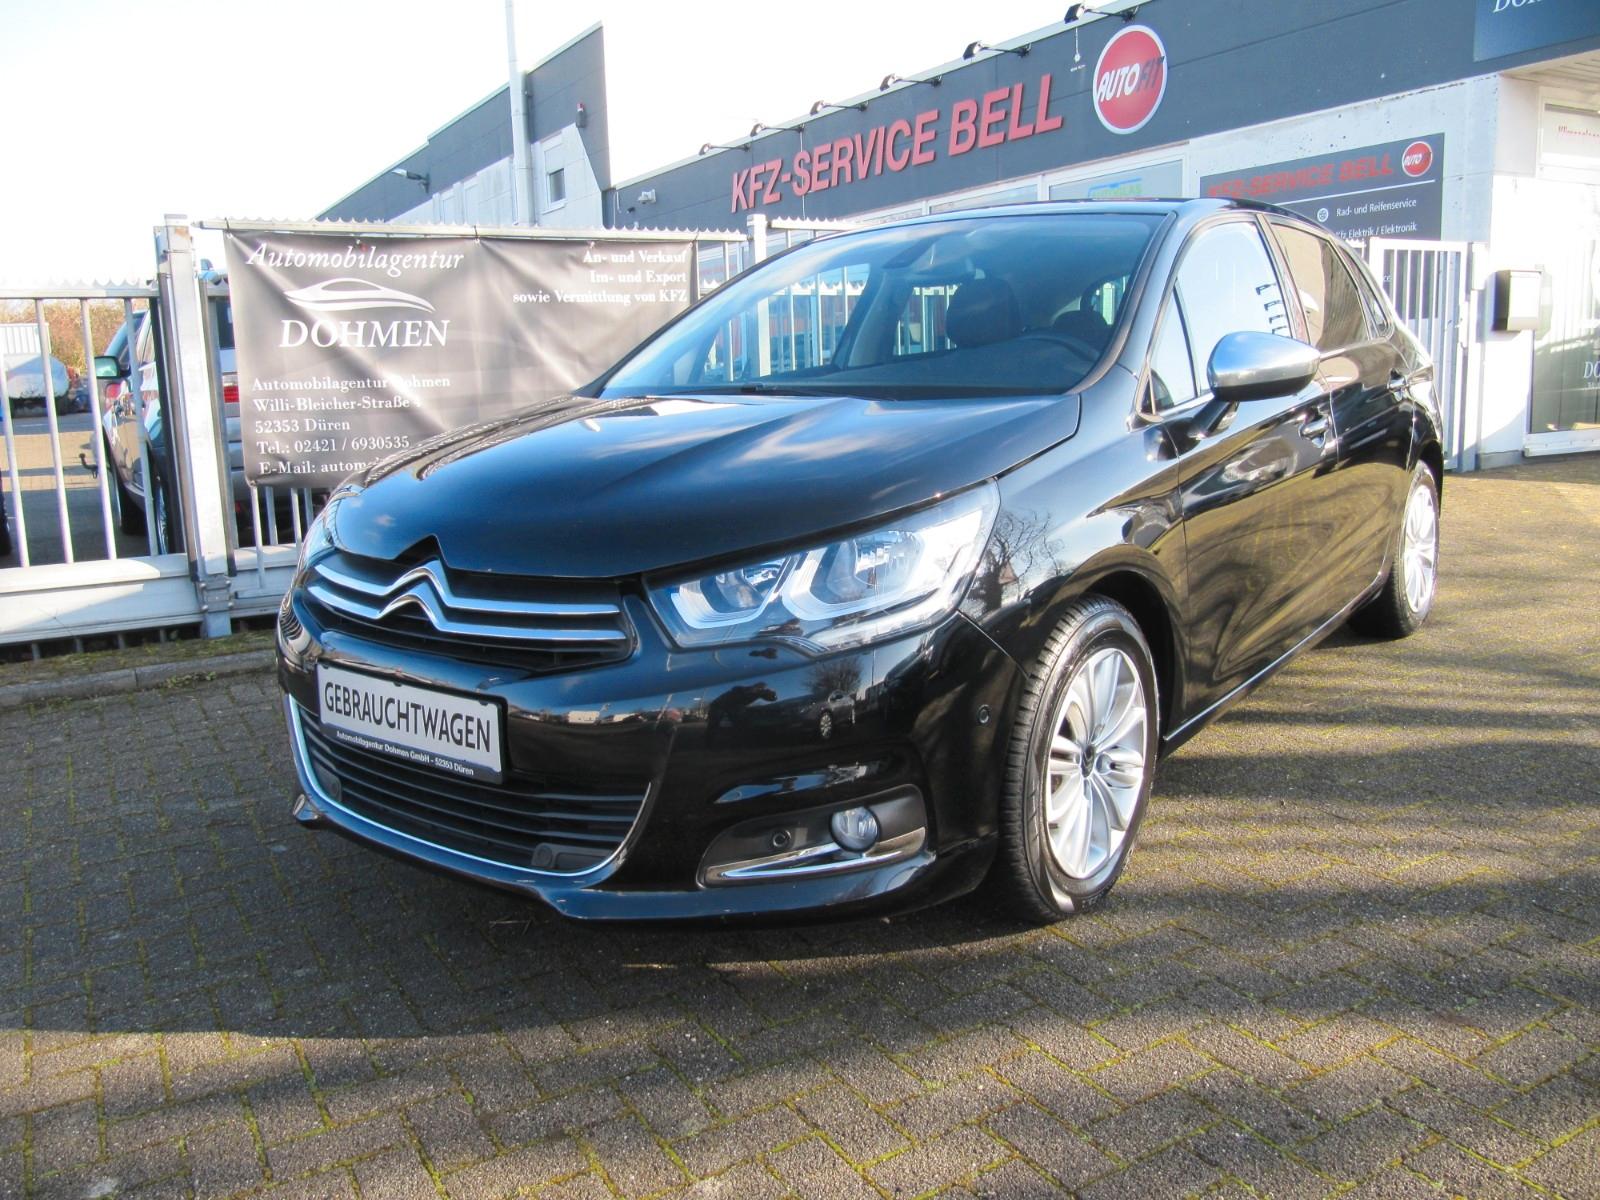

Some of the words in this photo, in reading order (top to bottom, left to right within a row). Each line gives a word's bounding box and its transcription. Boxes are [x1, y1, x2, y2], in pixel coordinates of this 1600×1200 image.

[730, 109, 939, 214] KFZ-SERVICE
[948, 73, 1063, 156] BELL
[1339, 154, 1393, 182] BELL
[1336, 206, 1352, 217] Rad-
[1353, 203, 1368, 214] und
[1369, 198, 1417, 212] Reifenservice
[1348, 227, 1374, 239] Elektrik
[1375, 227, 1380, 236] /
[1380, 221, 1417, 235] Elektronik
[245, 243, 464, 277] Automobilagentur
[583, 251, 607, 263] An-
[611, 250, 635, 263] und
[639, 249, 687, 263] Verkauf
[590, 270, 614, 283] Im-
[618, 270, 642, 283] und
[646, 270, 687, 286] Export
[512, 290, 550, 303] sowie
[554, 289, 632, 305] Vermittlung
[634, 293, 657, 302] von
[658, 289, 688, 302] KFZ
[278, 318, 450, 348] DOHMEN
[252, 376, 388, 392] Automobilagentur
[397, 374, 451, 388] ohmen
[253, 396, 410, 412] Willi-Bleicher-Straße
[255, 421, 300, 433] 52353
[304, 418, 351, 432] Düren
[256, 441, 290, 455] Tel.:
[294, 439, 336, 453] 02421
[341, 438, 347, 451] /
[351, 435, 410, 450] 6930535
[259, 462, 316, 474] E-Mail:
[325, 681, 490, 752] GEBRAUCHTWAGEN
[337, 730, 383, 750] Automobilagentur
[384, 743, 409, 758] Dohmen
[410, 751, 430, 763] GmbH
[453, 762, 474, 776] Düren
